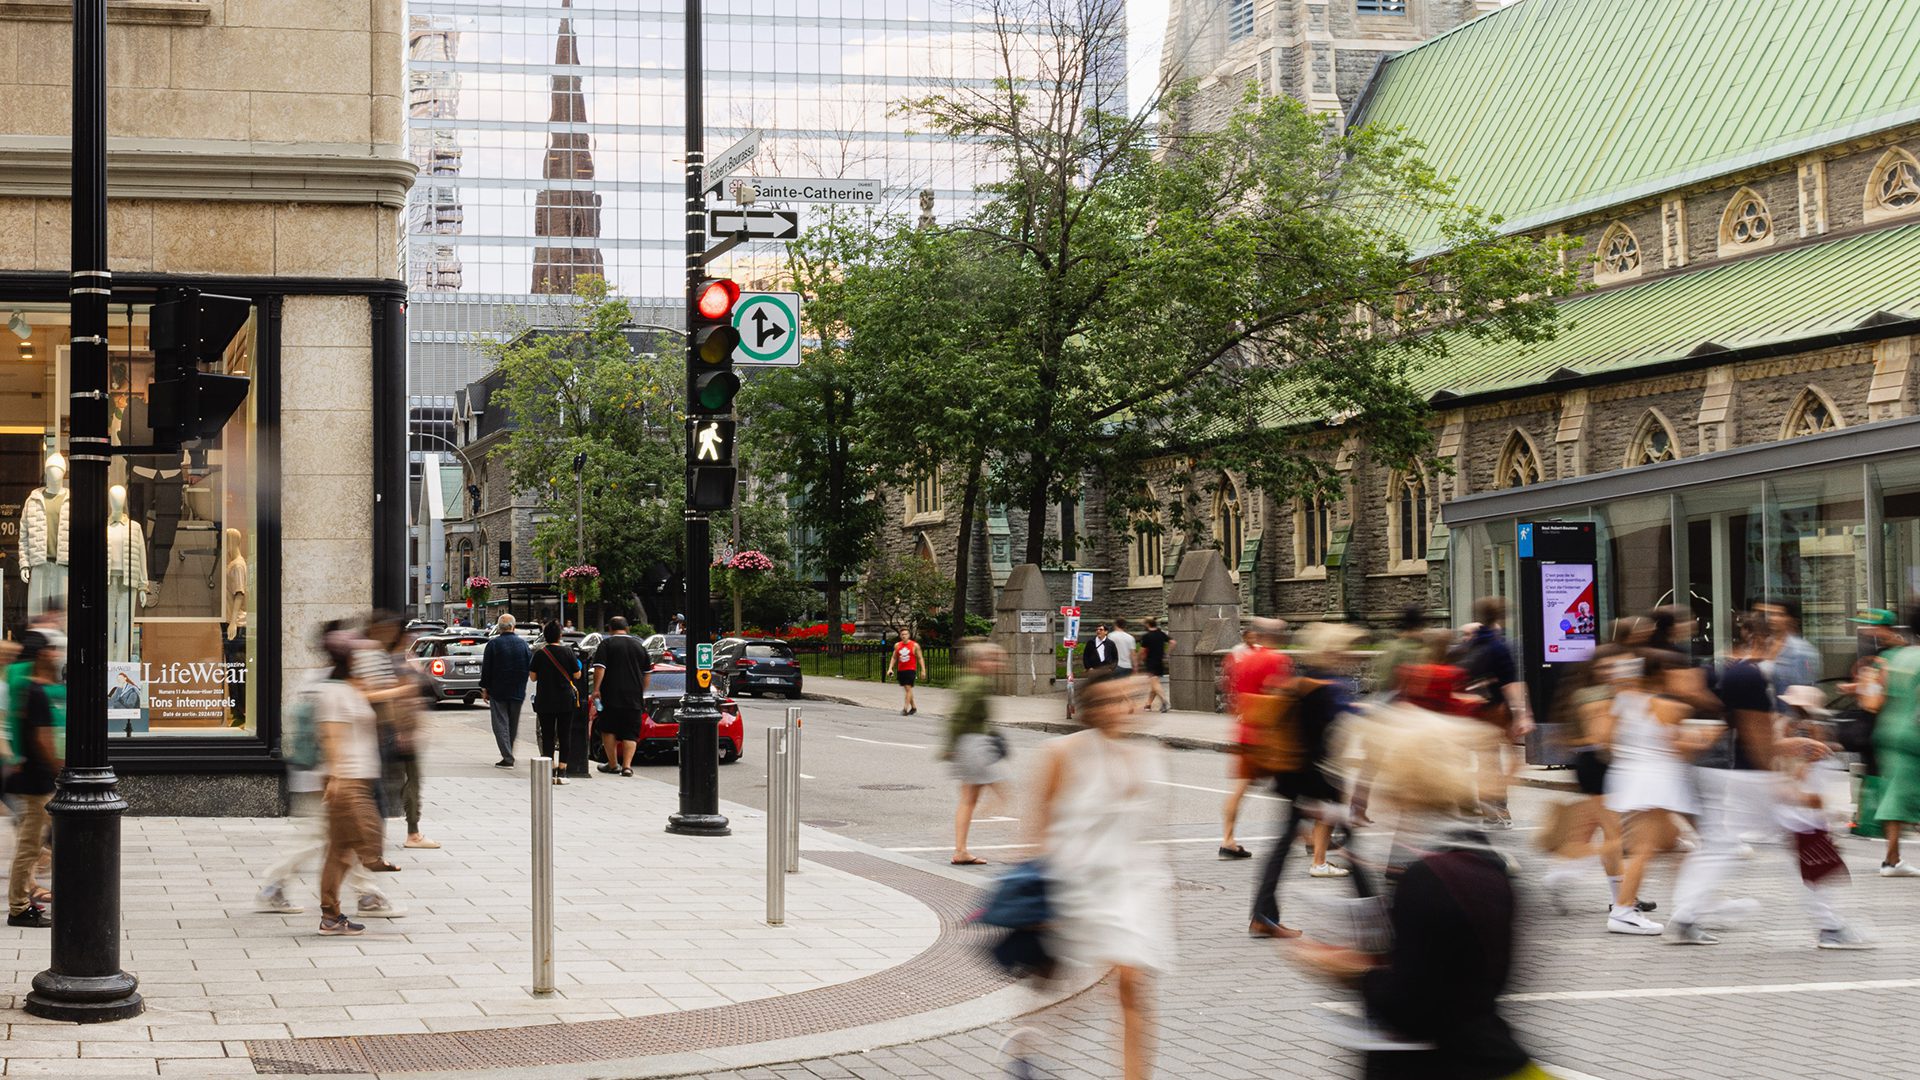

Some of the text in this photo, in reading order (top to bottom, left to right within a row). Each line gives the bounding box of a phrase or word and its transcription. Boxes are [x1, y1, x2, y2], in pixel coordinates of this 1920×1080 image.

[710, 144, 755, 181] Robert-Bourassa
[752, 185, 874, 200] Sainte-Catherine
[142, 662, 248, 684] LifeWear
[149, 697, 236, 710] Tons intemporels
